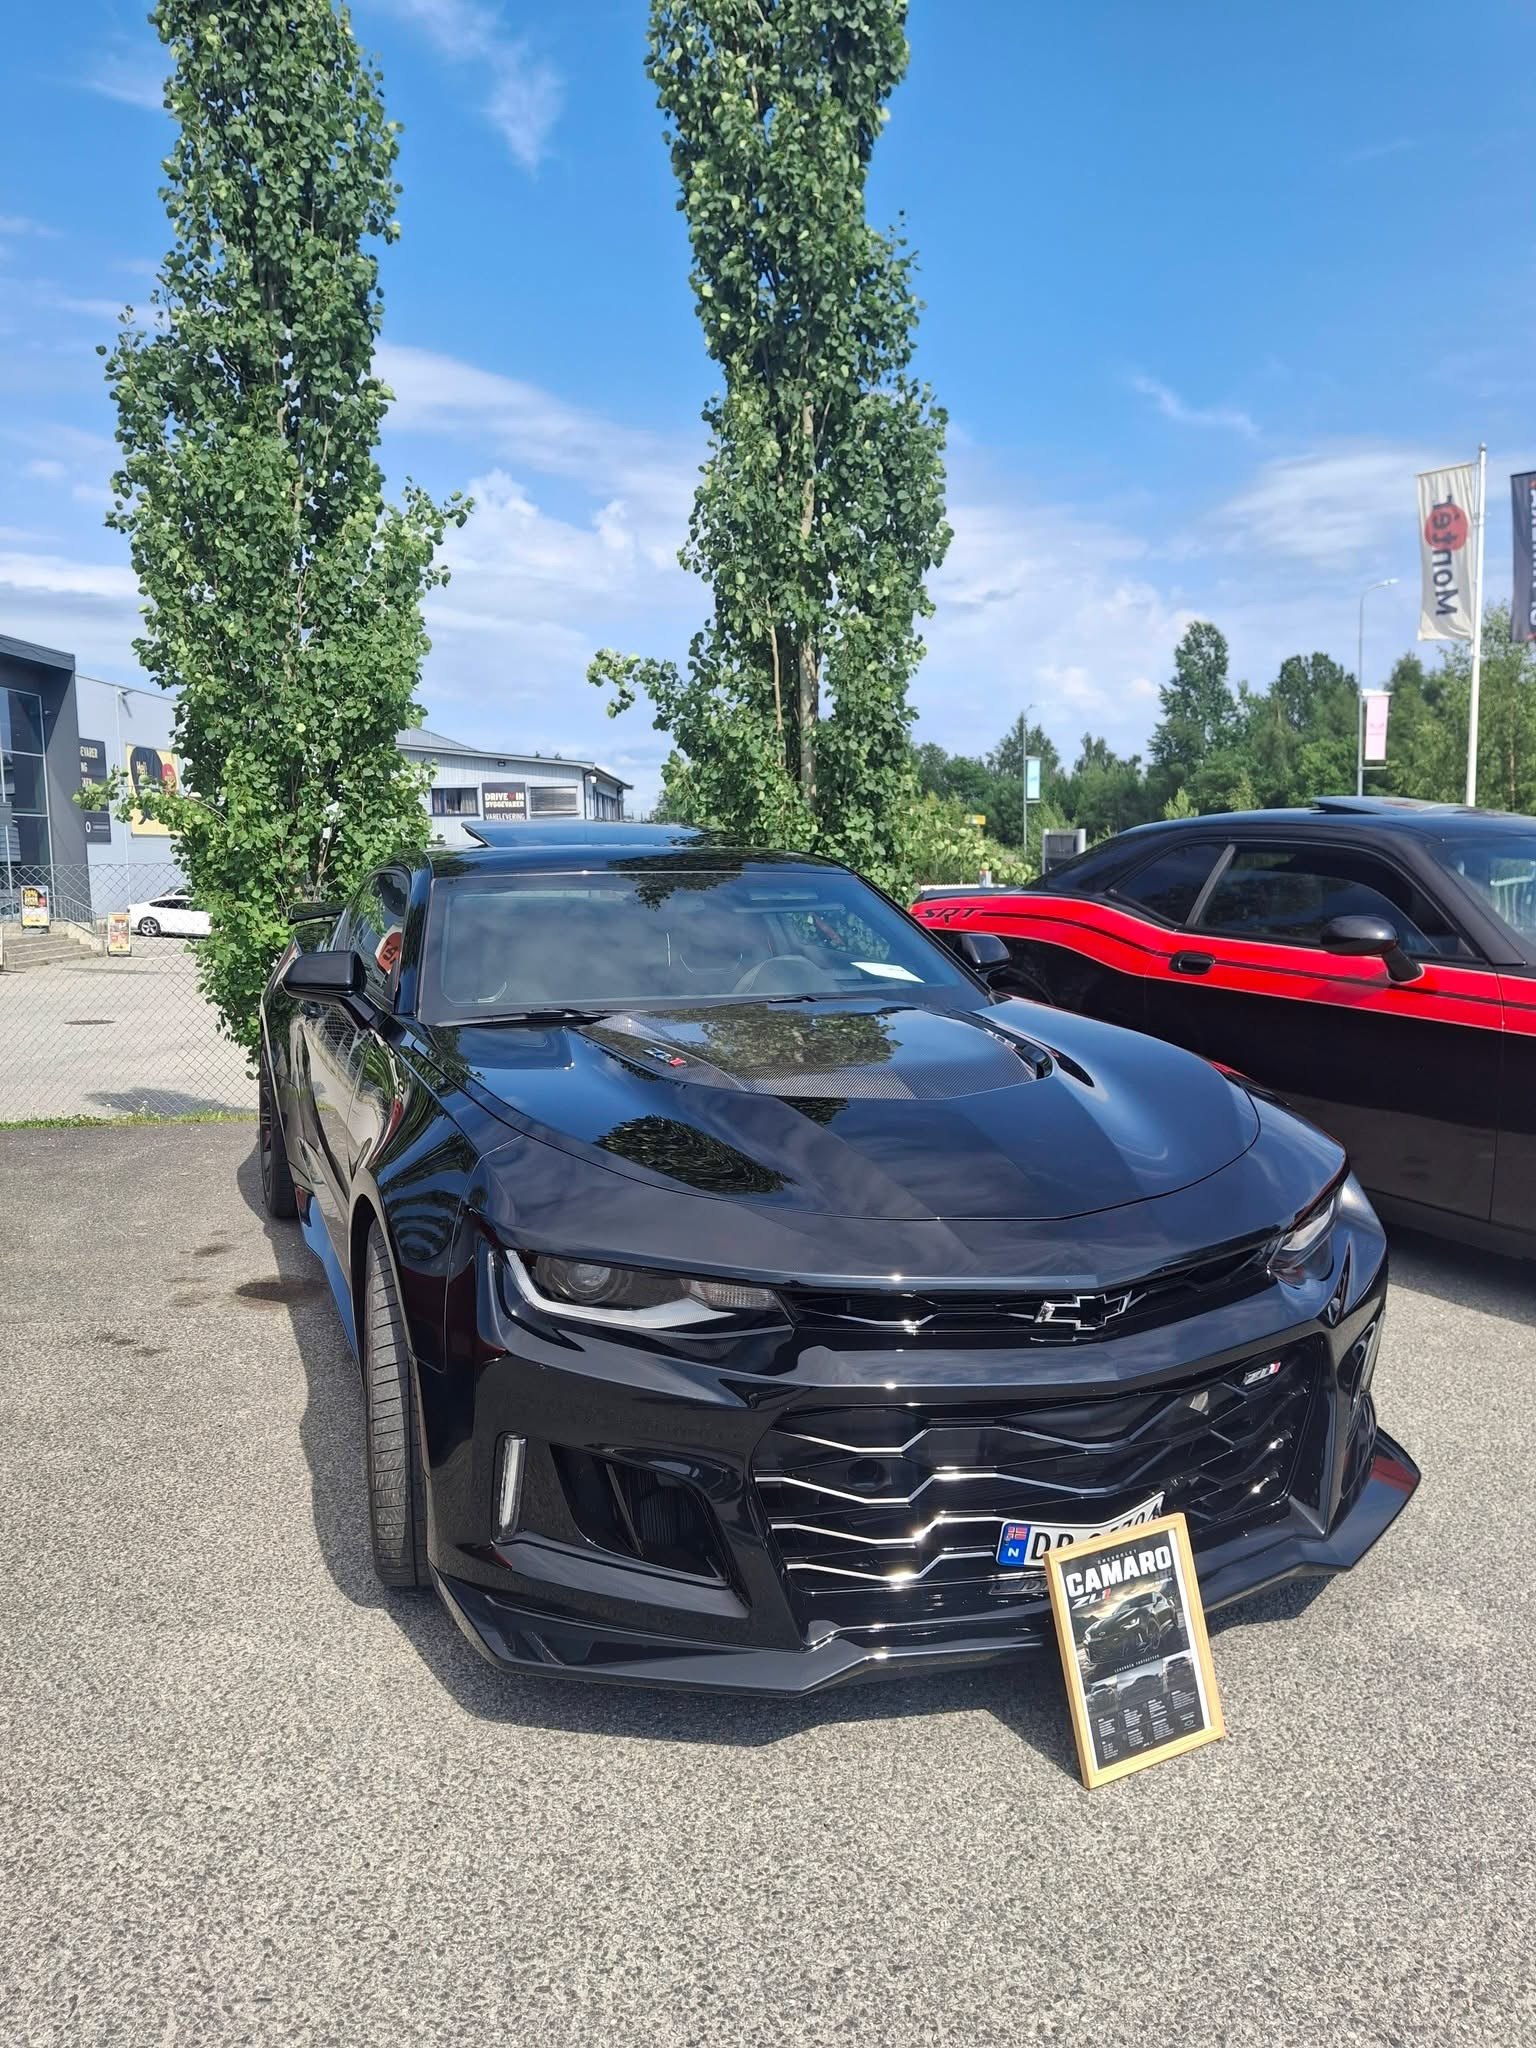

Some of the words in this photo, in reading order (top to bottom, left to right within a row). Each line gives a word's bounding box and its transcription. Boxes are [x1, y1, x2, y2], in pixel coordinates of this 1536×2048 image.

[484, 792, 508, 801] DRIVE
[515, 792, 525, 801] IN
[917, 907, 984, 923] SRT
[1007, 1547, 1020, 1558] N
[1065, 1545, 1173, 1598] CAMARO
